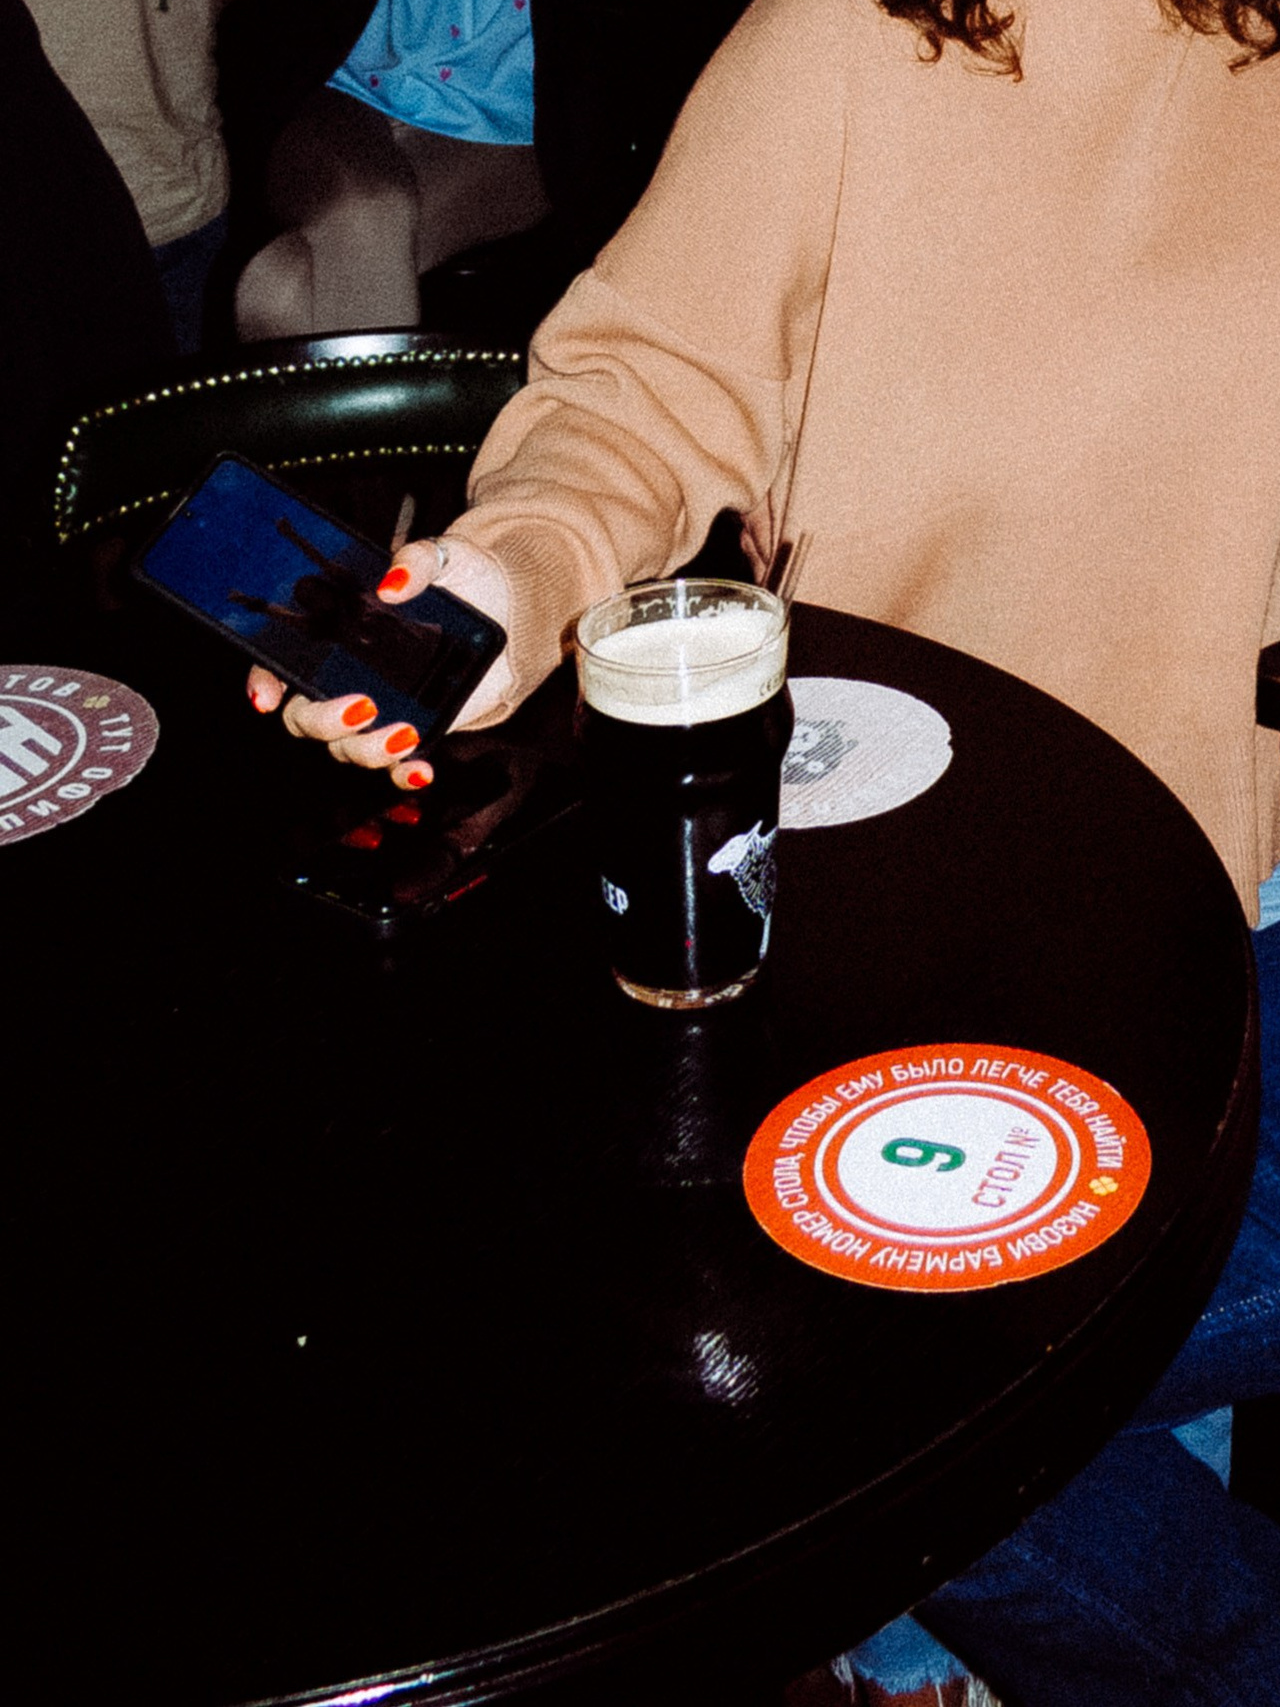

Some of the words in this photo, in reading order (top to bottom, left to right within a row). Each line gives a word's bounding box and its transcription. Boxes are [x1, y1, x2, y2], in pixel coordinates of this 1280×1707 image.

[837, 1070, 885, 1102] ЕМУ
[890, 1057, 965, 1082] БЫЛО
[970, 1058, 1049, 1089] ЛЕГЧЕ
[1046, 1078, 1099, 1117] ТЕБЯ
[779, 1096, 840, 1151] ЧТОБЫ
[1085, 1113, 1125, 1170] НАЙТИ
[971, 1150, 1031, 1208] СТОЛ
[792, 1210, 870, 1262] НОМЕР
[1010, 1200, 1101, 1258] НАЗОВИ
[869, 1243, 1002, 1274] БАРМЕНУ
